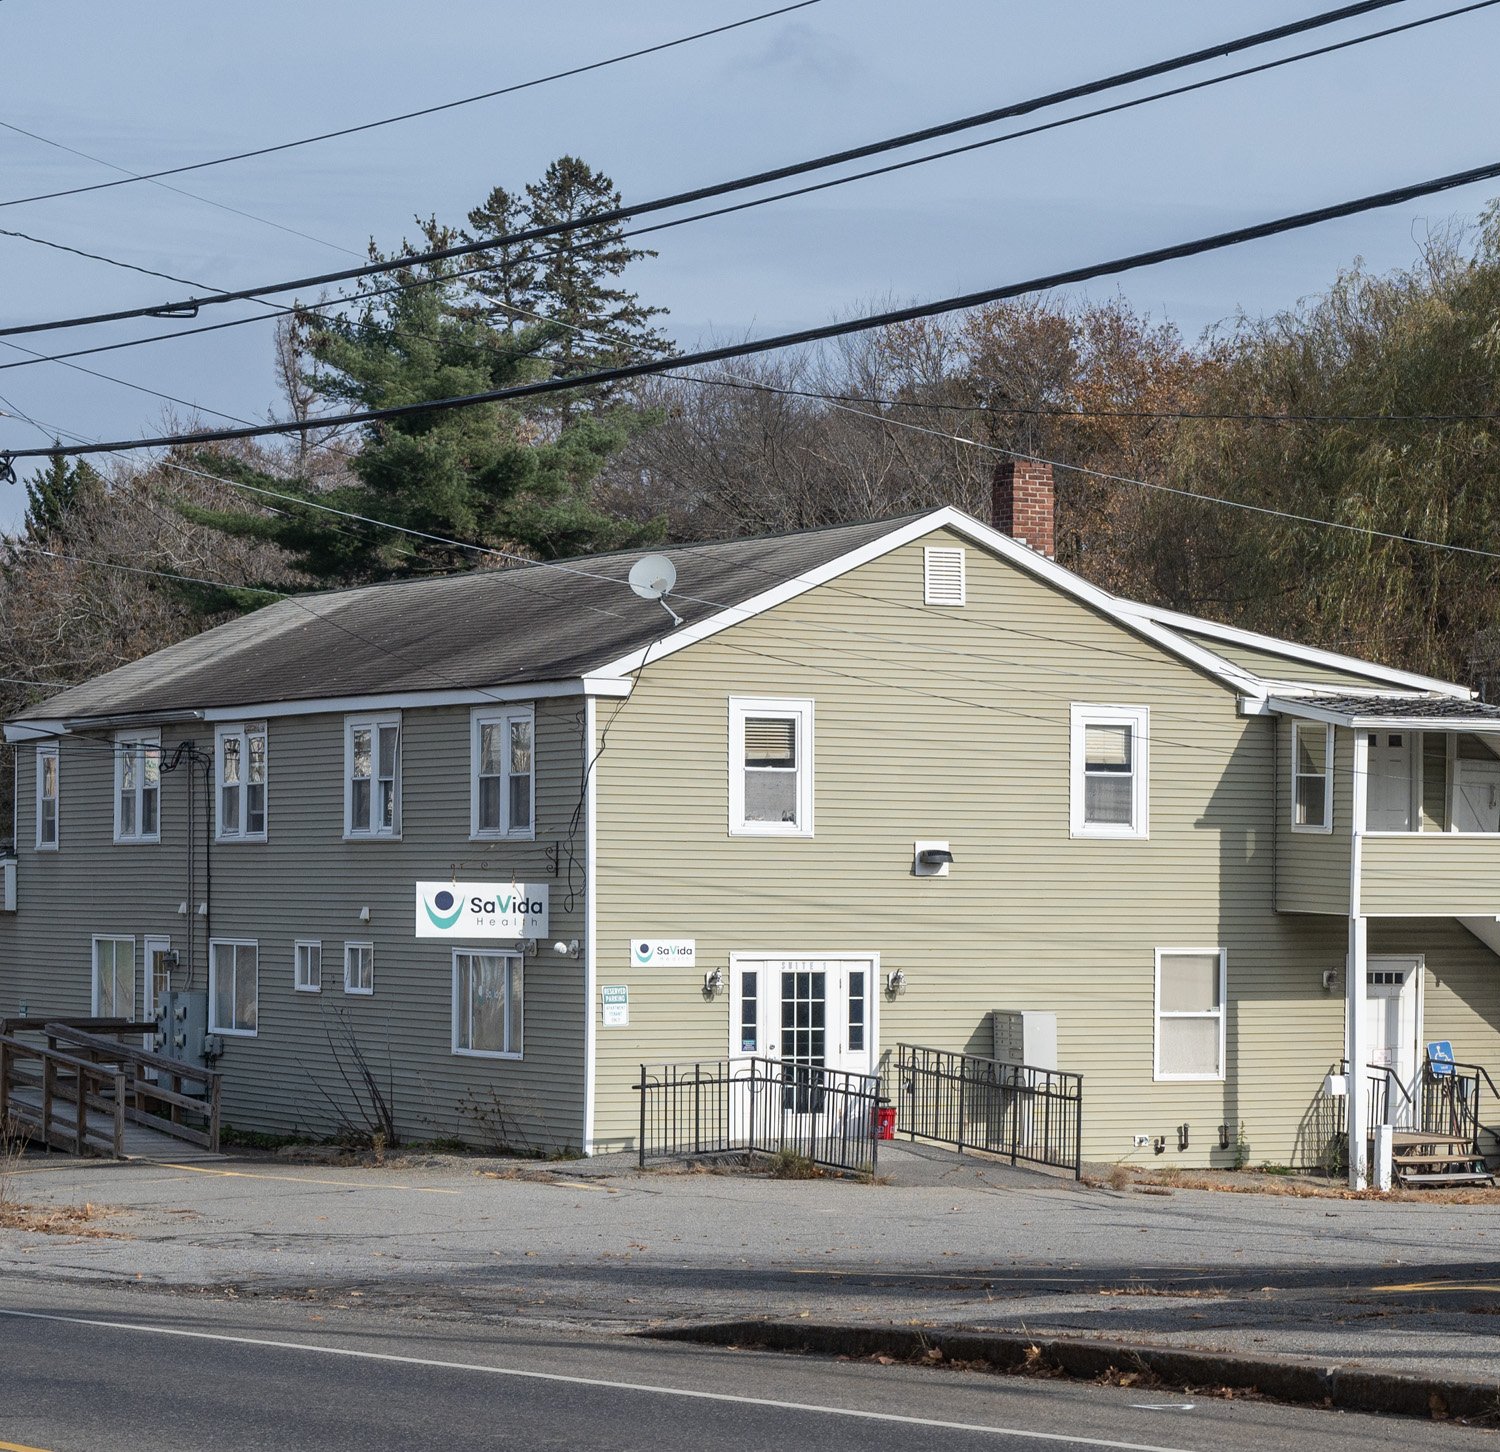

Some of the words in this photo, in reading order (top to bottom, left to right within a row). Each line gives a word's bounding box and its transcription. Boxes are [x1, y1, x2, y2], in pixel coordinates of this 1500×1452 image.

[470, 895, 543, 914] SaVida
[477, 917, 538, 926] Health
[657, 945, 693, 956] SaVida
